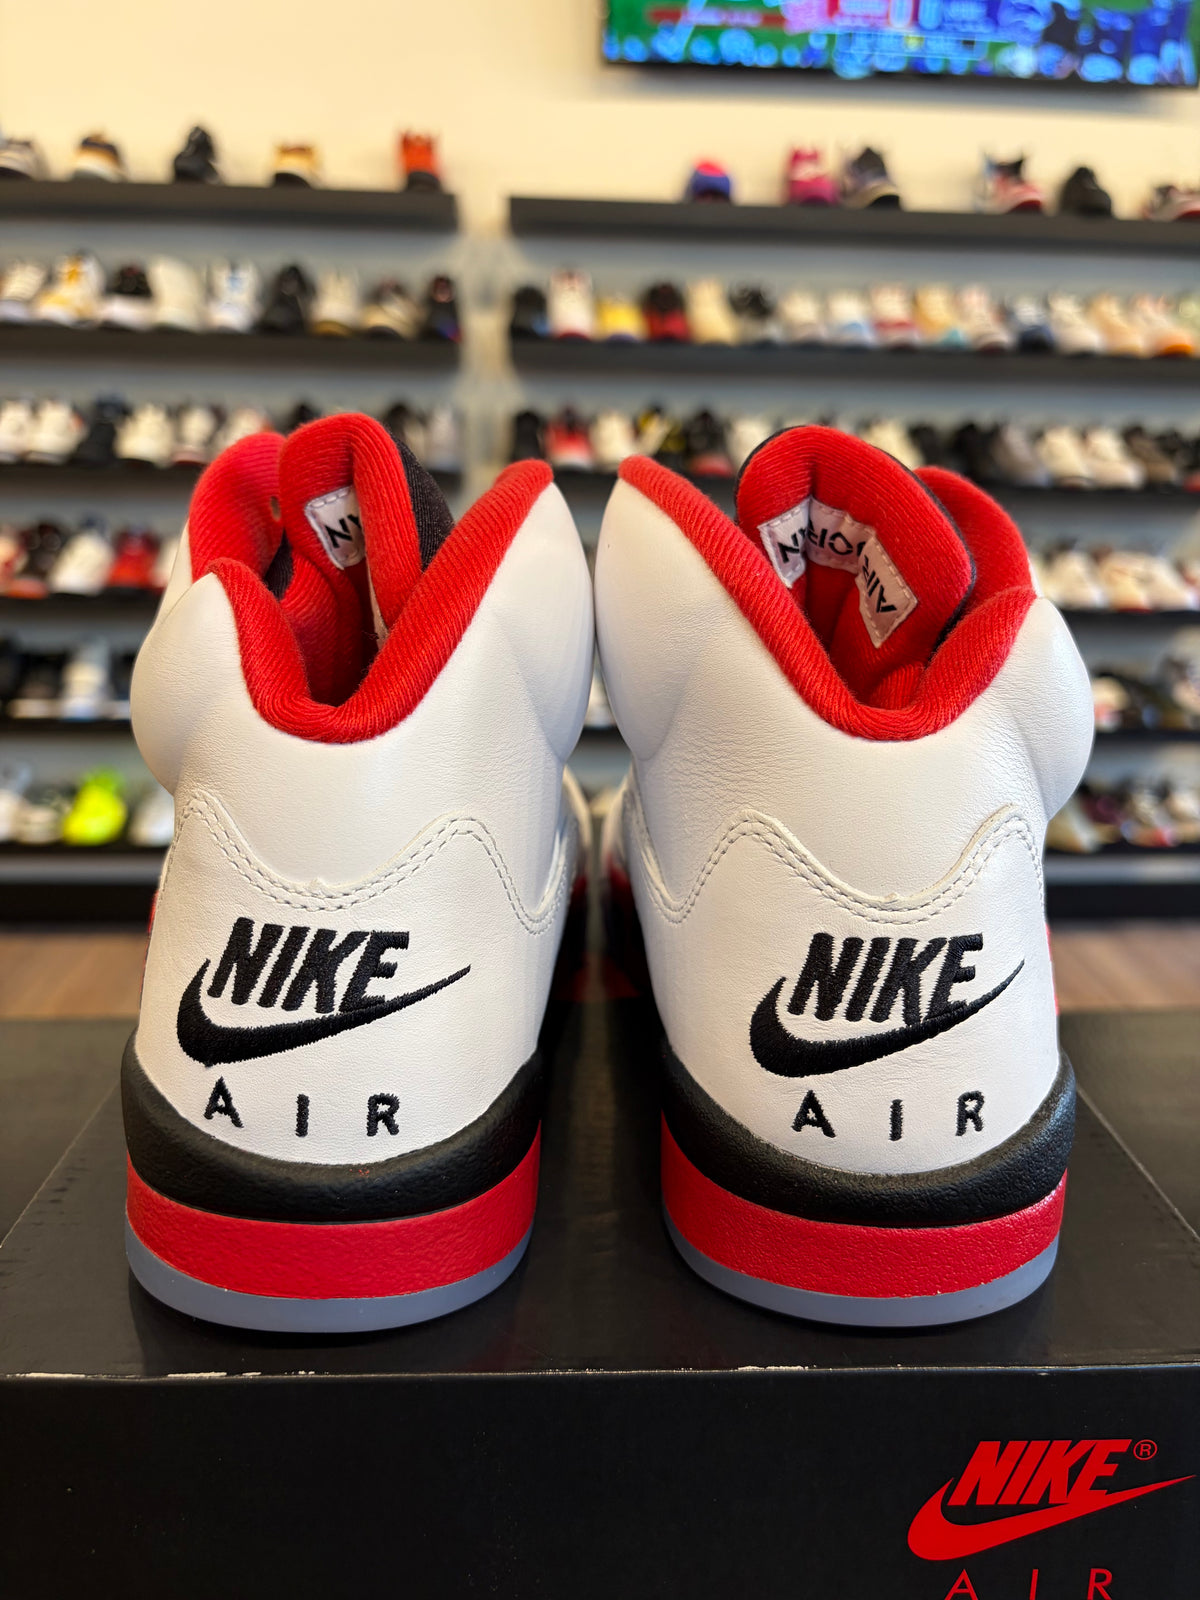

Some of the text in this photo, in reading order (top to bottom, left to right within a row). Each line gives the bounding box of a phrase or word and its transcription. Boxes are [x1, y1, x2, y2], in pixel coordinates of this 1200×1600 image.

[777, 519, 897, 613] AIR JORN
[207, 917, 410, 1014] NIKE
[787, 932, 984, 1027] NIKE
[203, 1076, 400, 1137] AIR
[791, 1090, 985, 1142] AIR
[943, 1568, 1113, 1600] AIR
